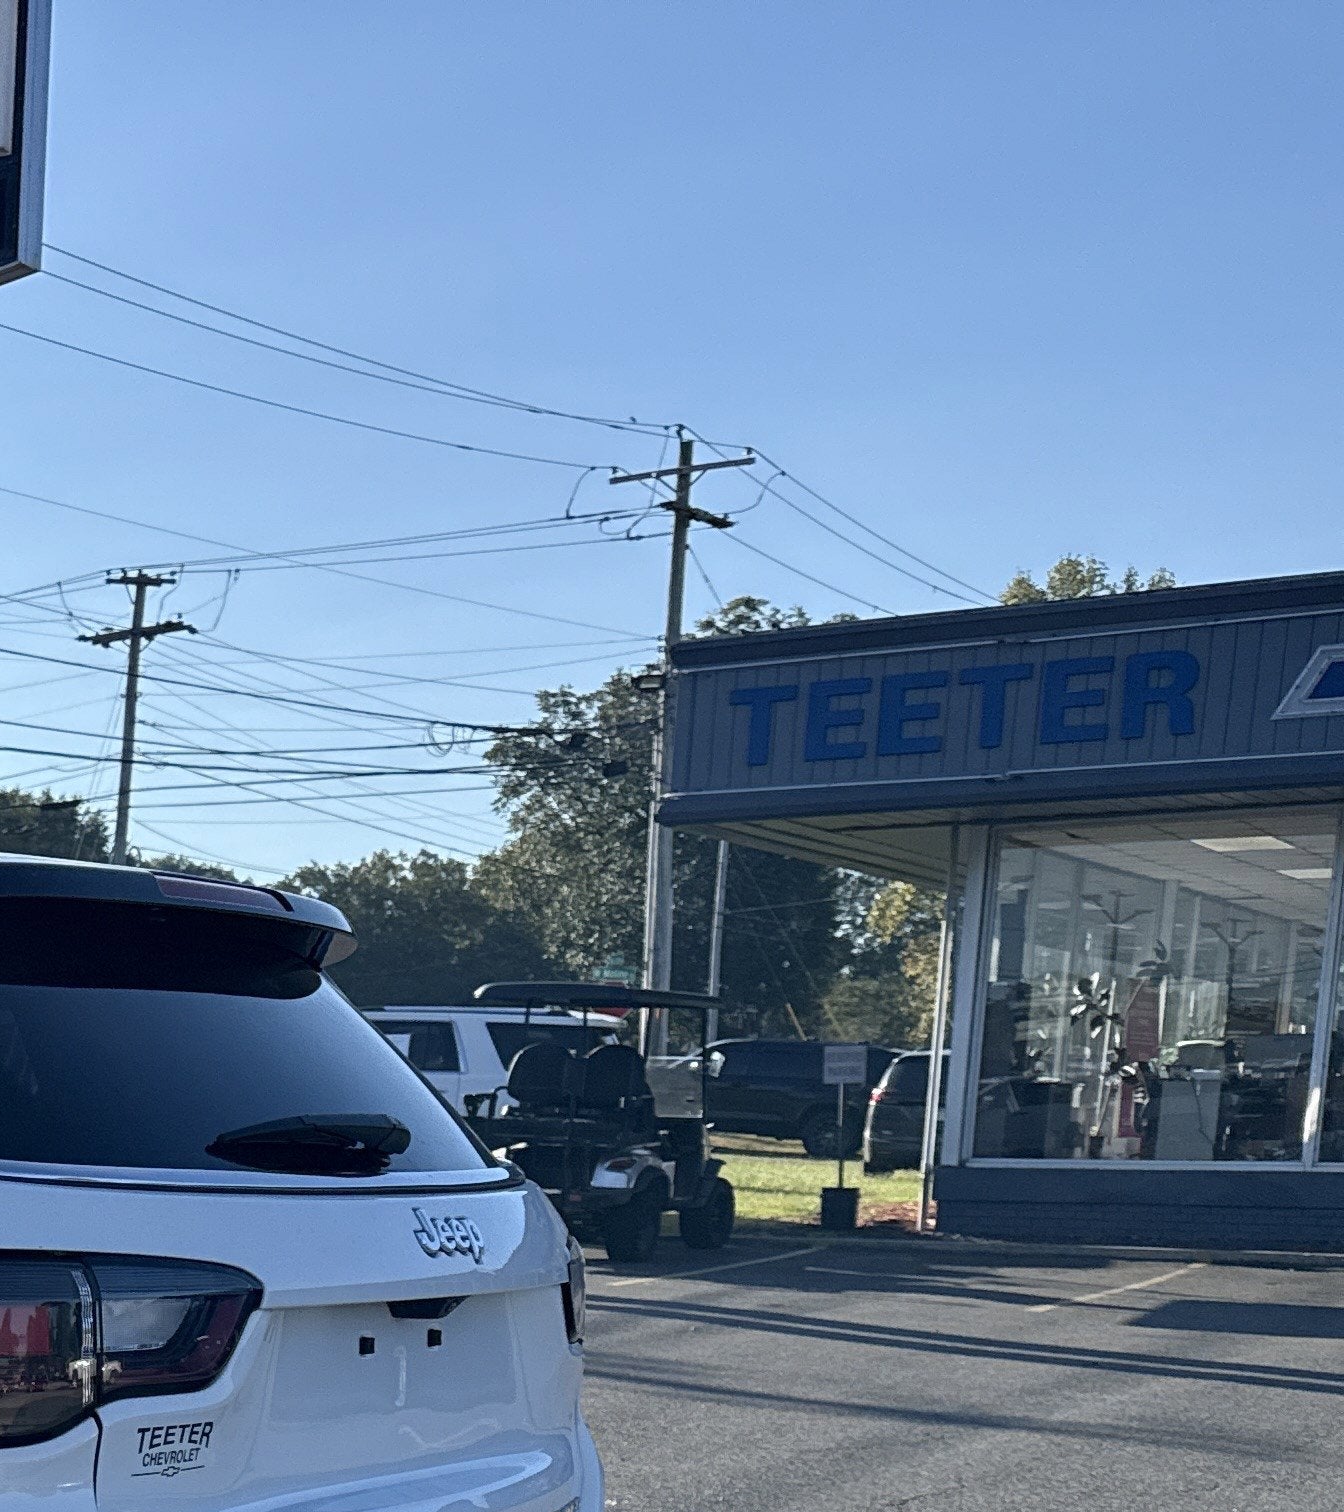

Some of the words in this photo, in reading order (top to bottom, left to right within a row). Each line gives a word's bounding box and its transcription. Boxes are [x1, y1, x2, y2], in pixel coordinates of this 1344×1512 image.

[730, 650, 1200, 767] TEETER
[412, 1207, 484, 1264] Jeep
[137, 1421, 213, 1454] TEETER
[142, 1447, 201, 1467] CHEVROLET
